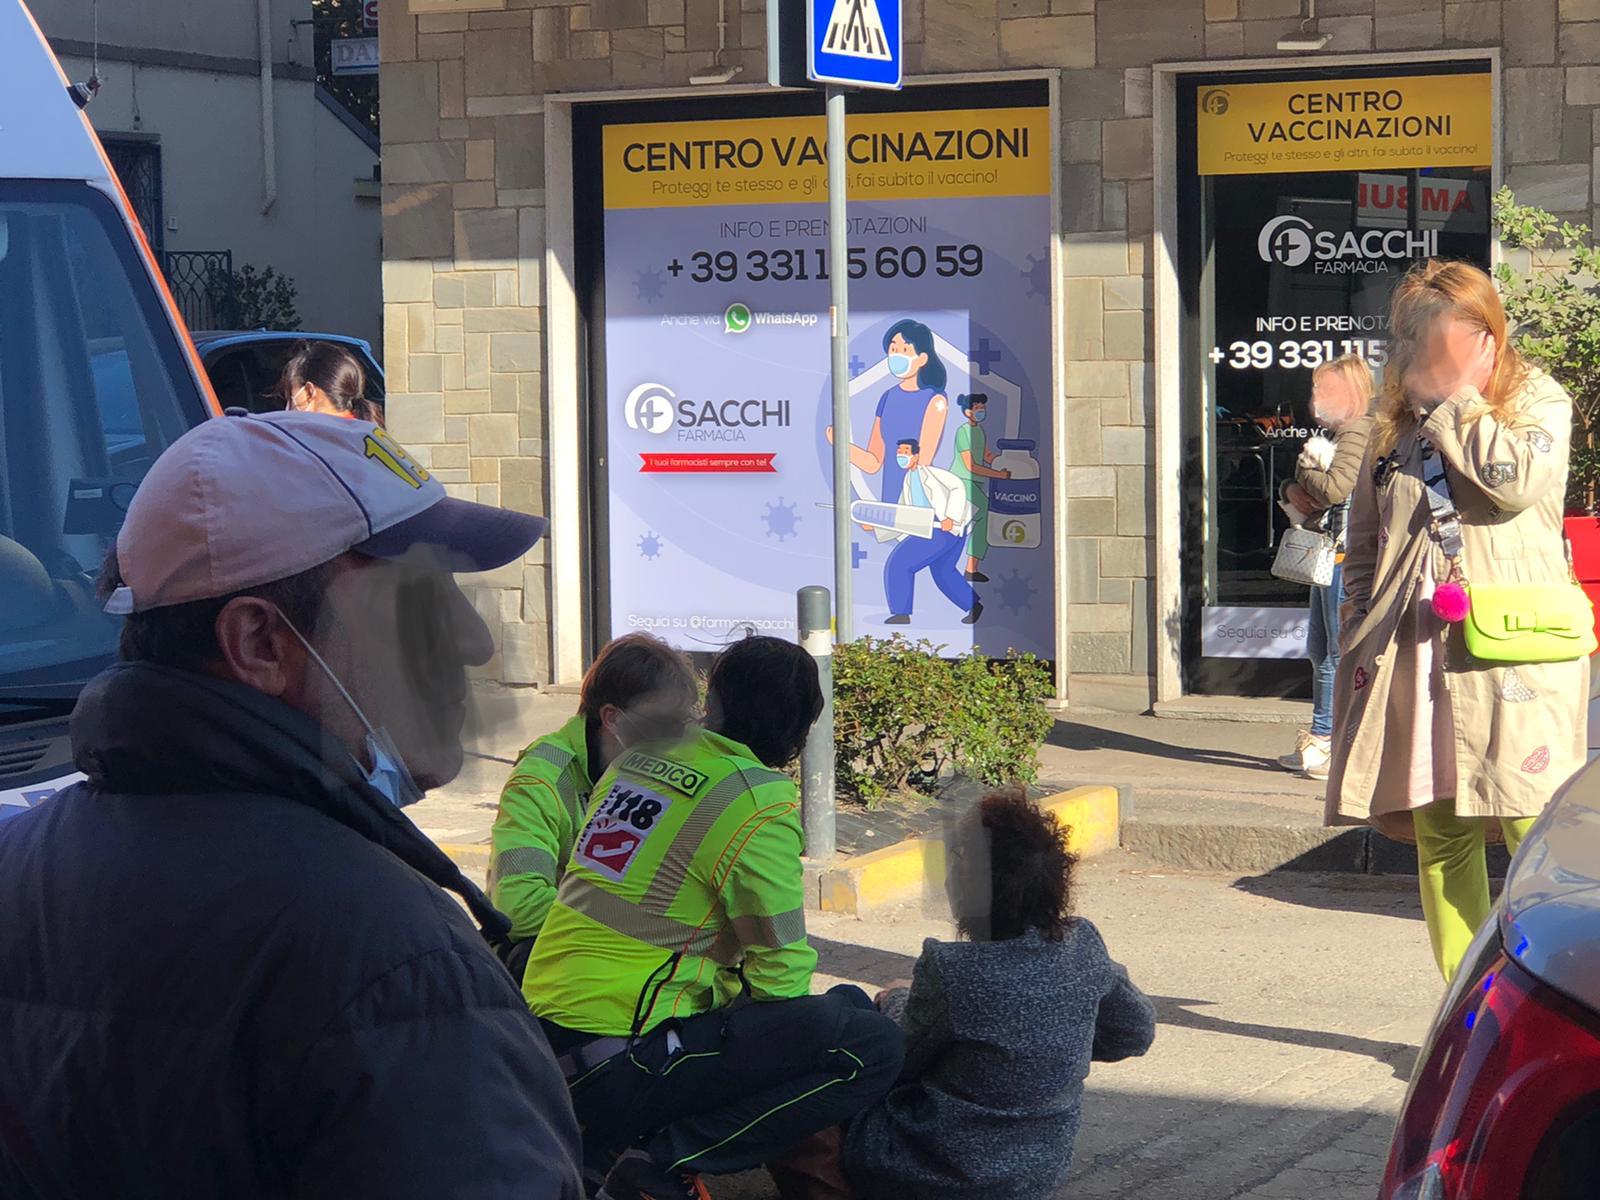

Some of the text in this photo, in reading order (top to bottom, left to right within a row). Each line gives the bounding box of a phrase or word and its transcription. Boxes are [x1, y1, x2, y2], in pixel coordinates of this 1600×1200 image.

[1288, 90, 1403, 115] CENTRO
[1248, 115, 1451, 143] VACCINAZIONI
[623, 127, 1029, 173] CENTRO VACINAZIONI
[1224, 151, 1269, 165] Proteggi
[1272, 151, 1283, 161] te
[1285, 150, 1322, 160] stesso
[1323, 151, 1331, 159] e
[652, 179, 712, 199] Proteggi
[716, 180, 730, 193] te
[735, 177, 783, 192] stesso
[788, 179, 798, 190] e
[803, 176, 818, 195] gli
[856, 172, 875, 187] fai
[878, 171, 925, 188] subito
[928, 171, 934, 185] il
[938, 169, 998, 185] vaccino!
[720, 220, 764, 239] INFO
[769, 220, 780, 237] E
[1314, 229, 1438, 260] SACCHI
[815, 247, 868, 279] 15
[875, 245, 926, 278] 60
[936, 244, 983, 277] 59
[1314, 260, 1389, 275] FARMACIA
[660, 312, 818, 326] Anche via WhatsApp
[1256, 316, 1297, 332] INFO
[1300, 316, 1312, 331] E
[677, 400, 790, 428] SACCHI
[677, 428, 746, 442] FARMACIA
[1264, 425, 1308, 438] Anche
[709, 459, 739, 468] sempre
[994, 491, 1037, 503] VACCINO
[628, 614, 671, 630] Seguici
[674, 618, 687, 628] su
[1217, 624, 1267, 643] Seguici
[1271, 629, 1288, 639] su
[626, 754, 698, 790] MEDICO
[607, 789, 662, 830] 118
